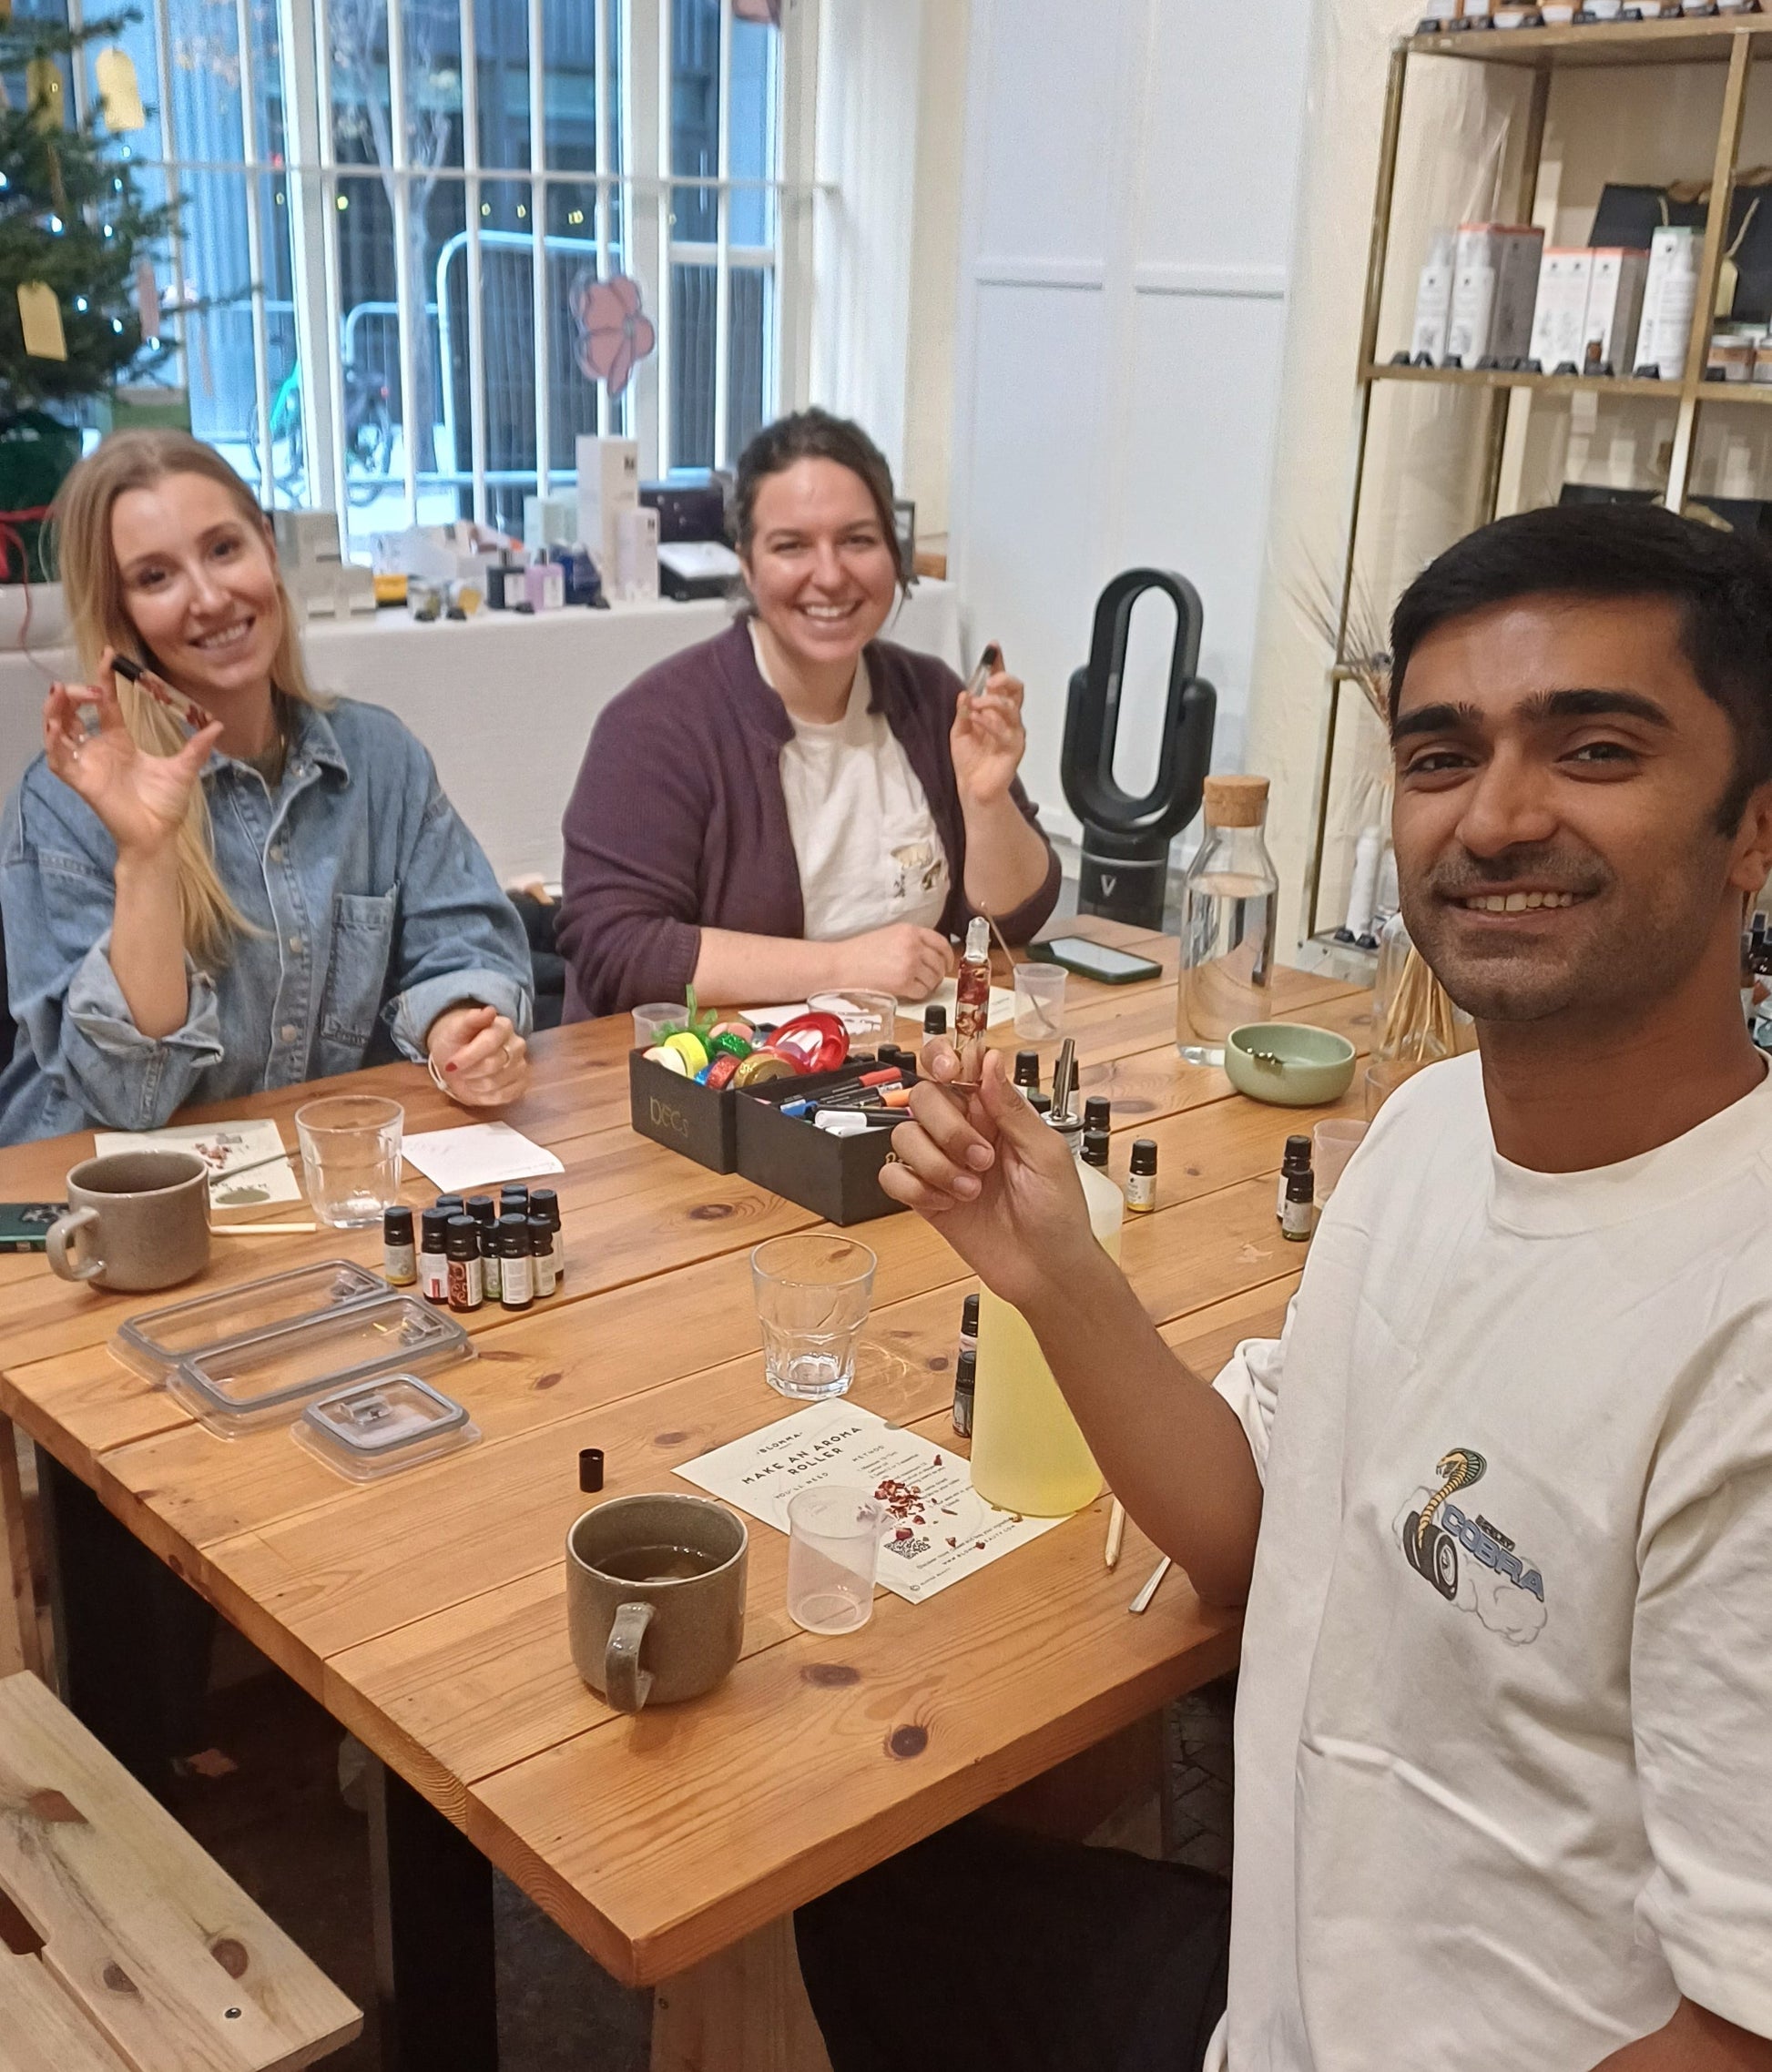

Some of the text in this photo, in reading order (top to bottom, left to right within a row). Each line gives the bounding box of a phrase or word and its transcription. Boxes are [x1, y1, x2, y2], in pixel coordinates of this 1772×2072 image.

[1100, 873, 1117, 897] V
[741, 1427, 862, 1484] MAKE AN AROMA
[759, 1433, 801, 1454] BLOMMA
[787, 1447, 843, 1476] ROLLER
[806, 1472, 829, 1485] NEED
[1441, 1504, 1544, 1602] COBRA
